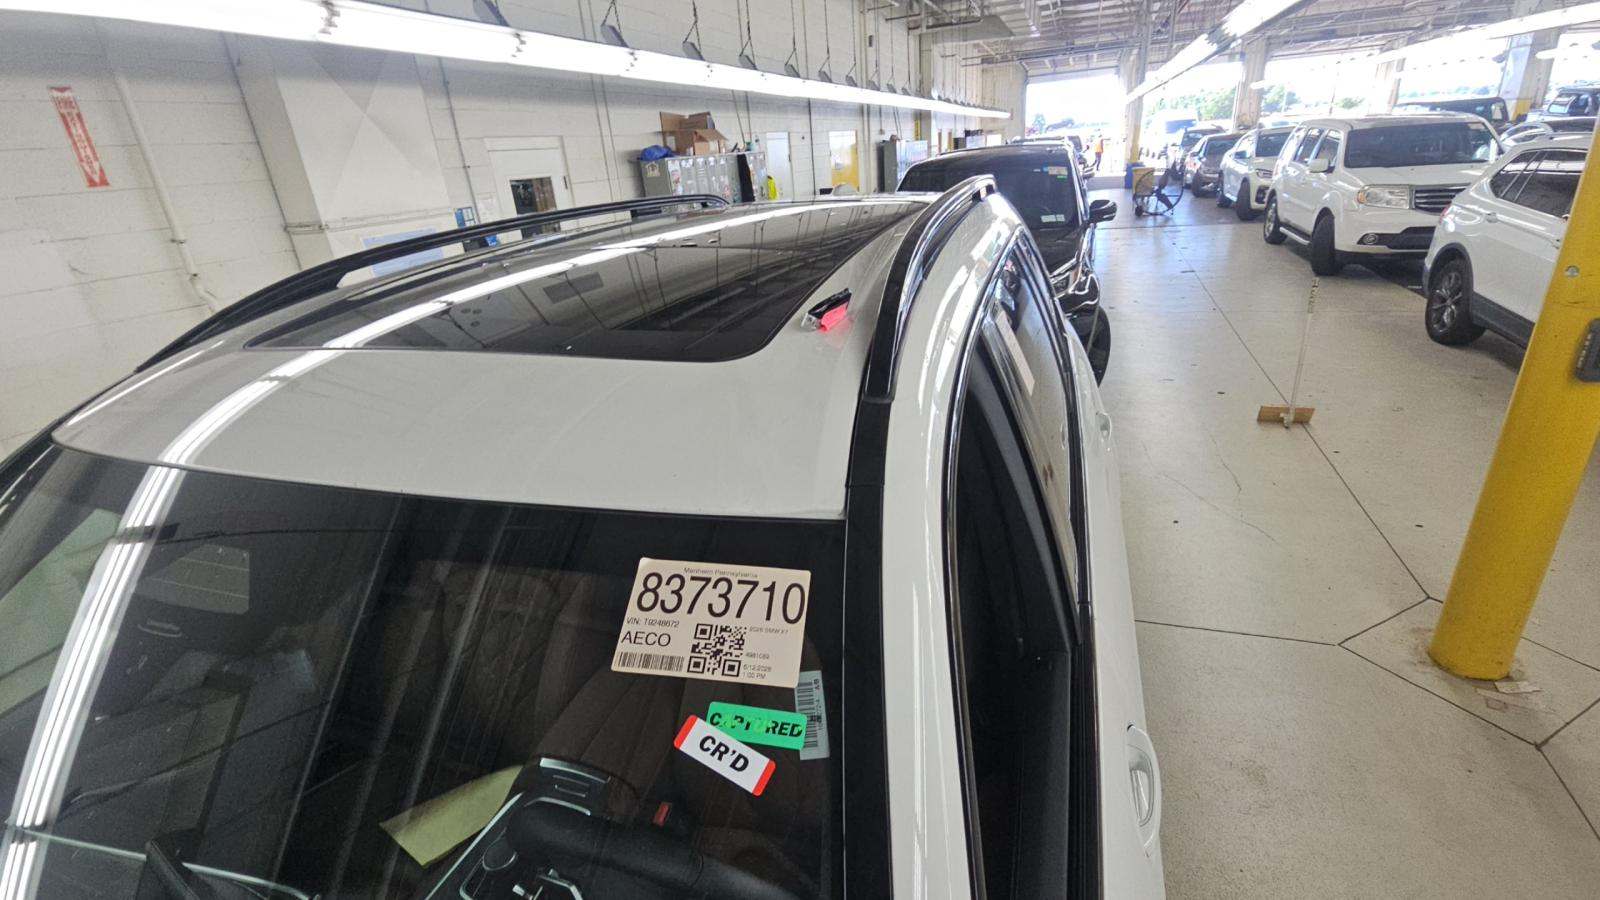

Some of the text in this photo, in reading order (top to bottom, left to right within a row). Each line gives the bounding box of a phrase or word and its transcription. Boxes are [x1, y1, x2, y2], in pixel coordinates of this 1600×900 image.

[636, 571, 806, 625] 8373710
[626, 616, 641, 625] VIN:
[620, 630, 671, 647] AECO
[699, 735, 750, 772] CR'D
